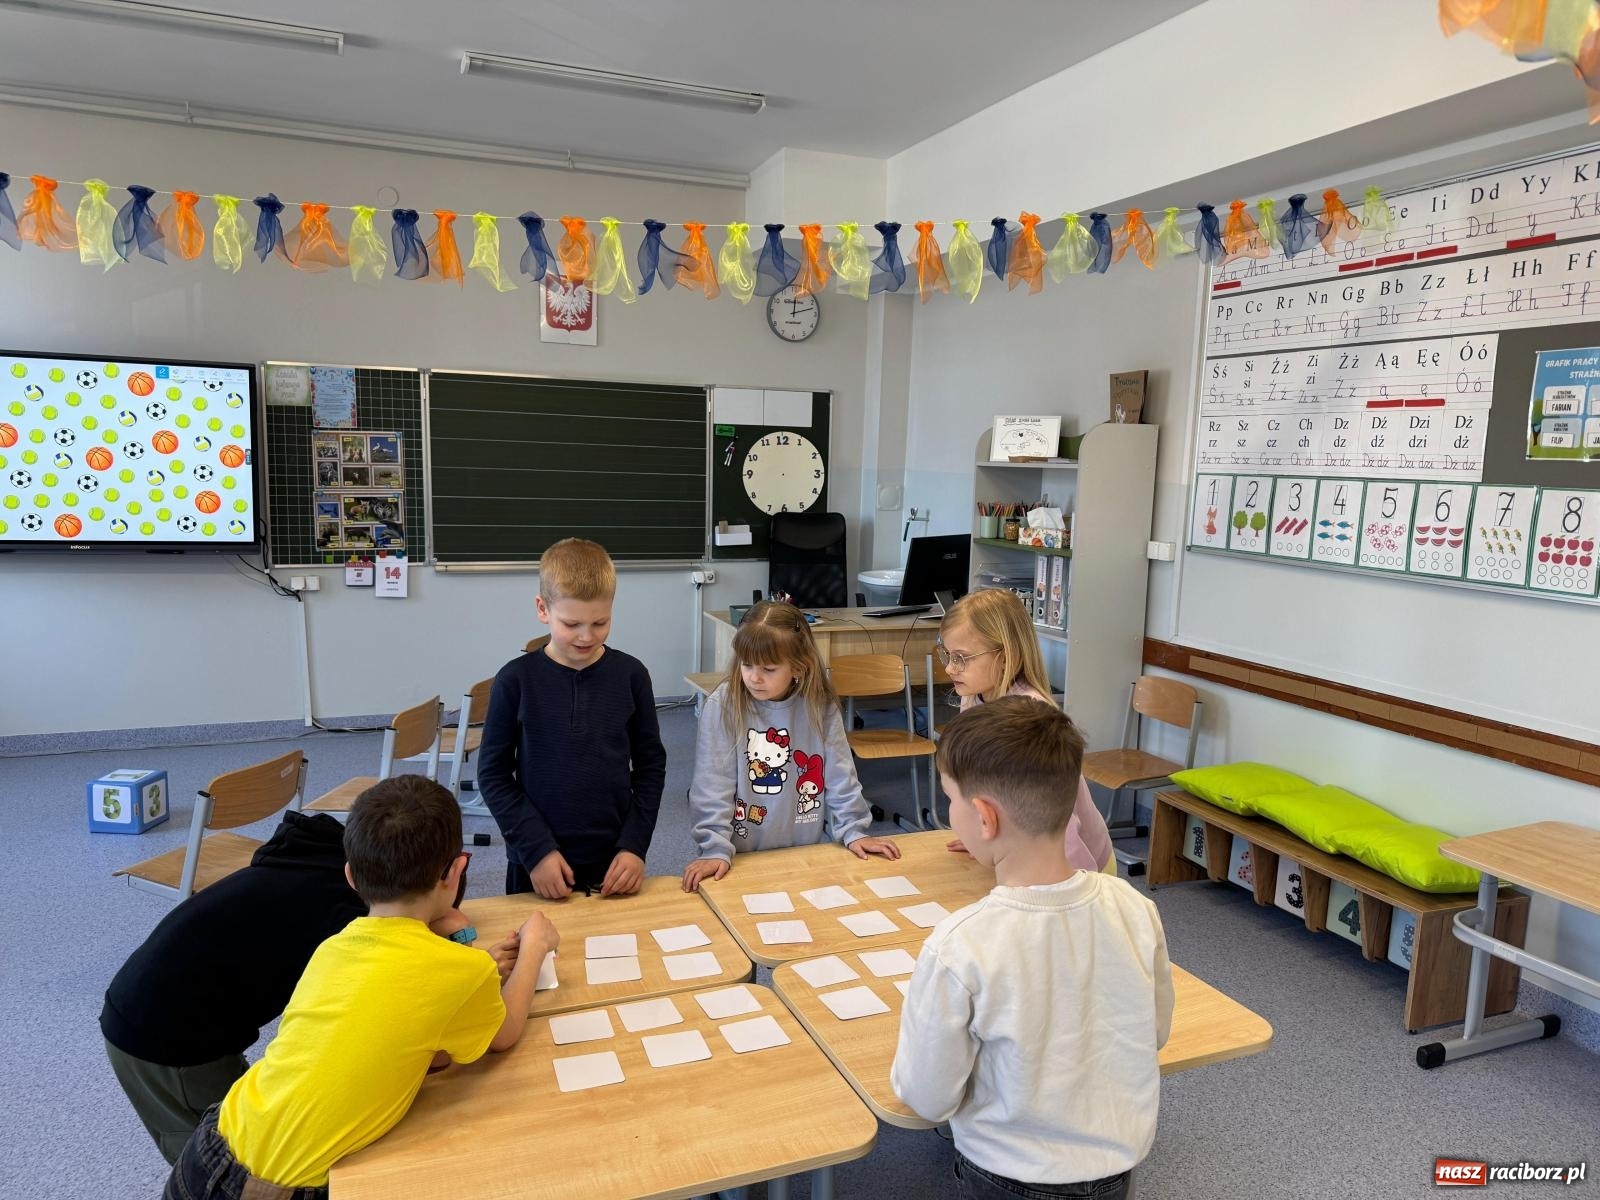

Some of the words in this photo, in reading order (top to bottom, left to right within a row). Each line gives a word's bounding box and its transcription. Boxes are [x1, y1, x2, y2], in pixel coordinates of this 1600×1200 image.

[1545, 359, 1571, 368] GRAFIK
[1572, 357, 1600, 366] PRACY
[1551, 403, 1572, 412] FABIAN
[1208, 420, 1221, 432] Rz
[1237, 420, 1249, 431] Sz
[1267, 419, 1281, 431] Cz
[1299, 418, 1313, 430] Ch
[1334, 417, 1350, 430] Dz
[1371, 416, 1388, 429] Dź
[1409, 415, 1431, 429] Dzi
[1454, 414, 1474, 429] Dż
[761, 438, 770, 447] 11
[776, 435, 790, 446] 12
[797, 438, 802, 446] 1
[1208, 439, 1218, 448] rz
[1237, 438, 1247, 448] sz
[1266, 439, 1277, 448] cz
[1298, 435, 1310, 448] ch
[1333, 434, 1347, 448] dz
[1370, 434, 1385, 448] dź
[1408, 434, 1427, 448] dzi
[1453, 434, 1470, 449] dż
[1550, 436, 1564, 445] FILIP
[748, 454, 758, 462] 10
[811, 452, 817, 460] 2
[746, 469, 754, 479] 9
[813, 469, 821, 479] 3
[751, 491, 757, 499] 8
[811, 487, 818, 495] 4
[767, 504, 772, 512] 7
[781, 503, 788, 513] 6
[799, 501, 805, 509] 5
[1209, 479, 1217, 506] 1
[1245, 480, 1259, 508] 2
[1288, 483, 1303, 512] 3
[1333, 484, 1346, 515] 4
[1381, 487, 1399, 519] 5
[1435, 489, 1453, 522] 6
[1498, 492, 1516, 527] 7
[1562, 496, 1583, 534] 8
[384, 566, 402, 580] 14
[103, 787, 122, 820] 5
[148, 784, 161, 818] 3
[735, 810, 744, 818] M
[1285, 873, 1305, 909] 3
[1337, 898, 1361, 937] 4
